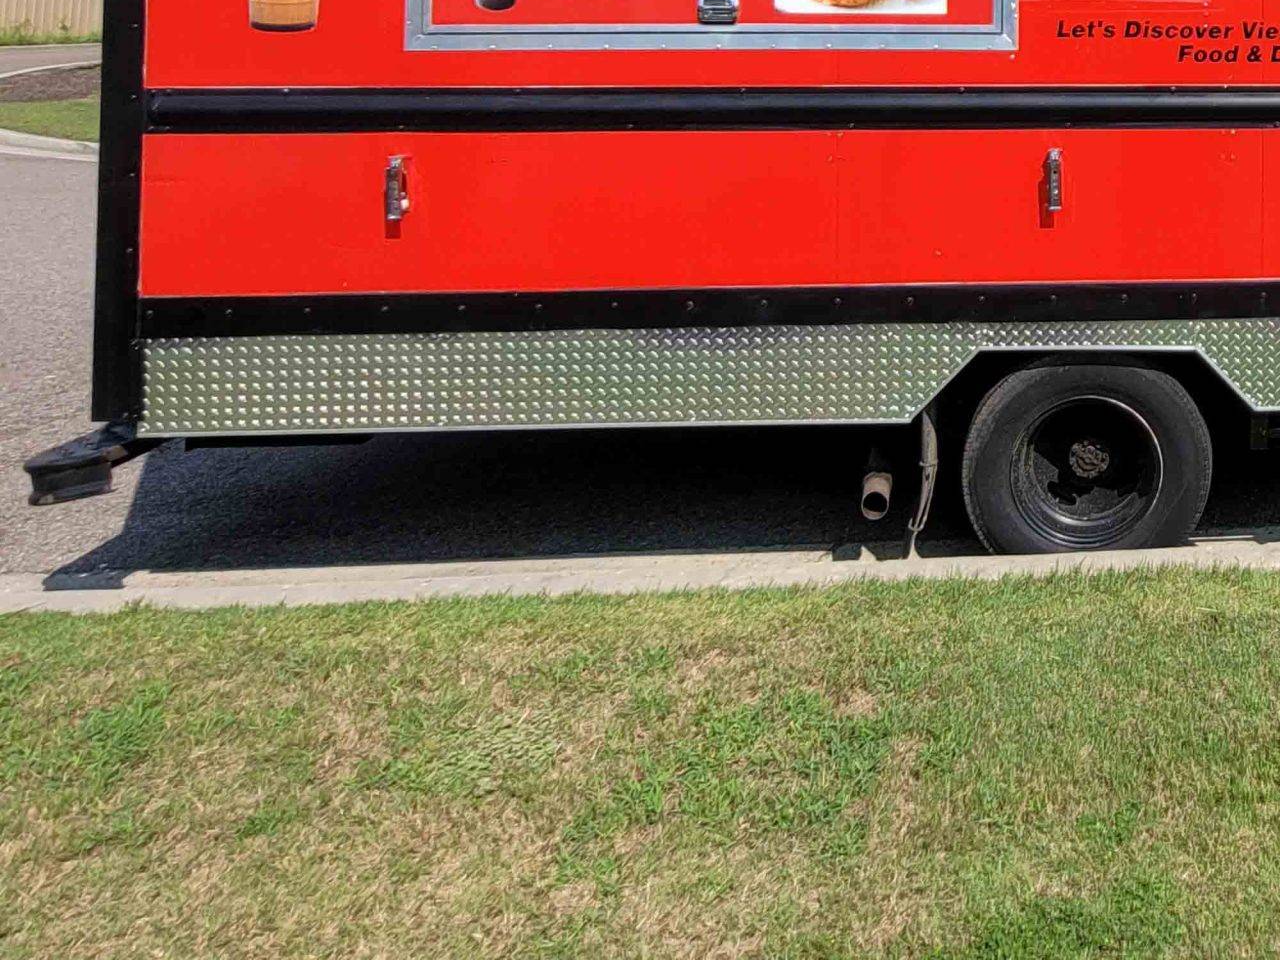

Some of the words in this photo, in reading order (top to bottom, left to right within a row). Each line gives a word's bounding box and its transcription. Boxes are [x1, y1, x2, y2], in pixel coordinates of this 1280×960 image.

[1057, 20, 1116, 39] Let's
[1123, 21, 1231, 40] Discover
[1178, 45, 1239, 63] Food
[1246, 45, 1262, 63] &
